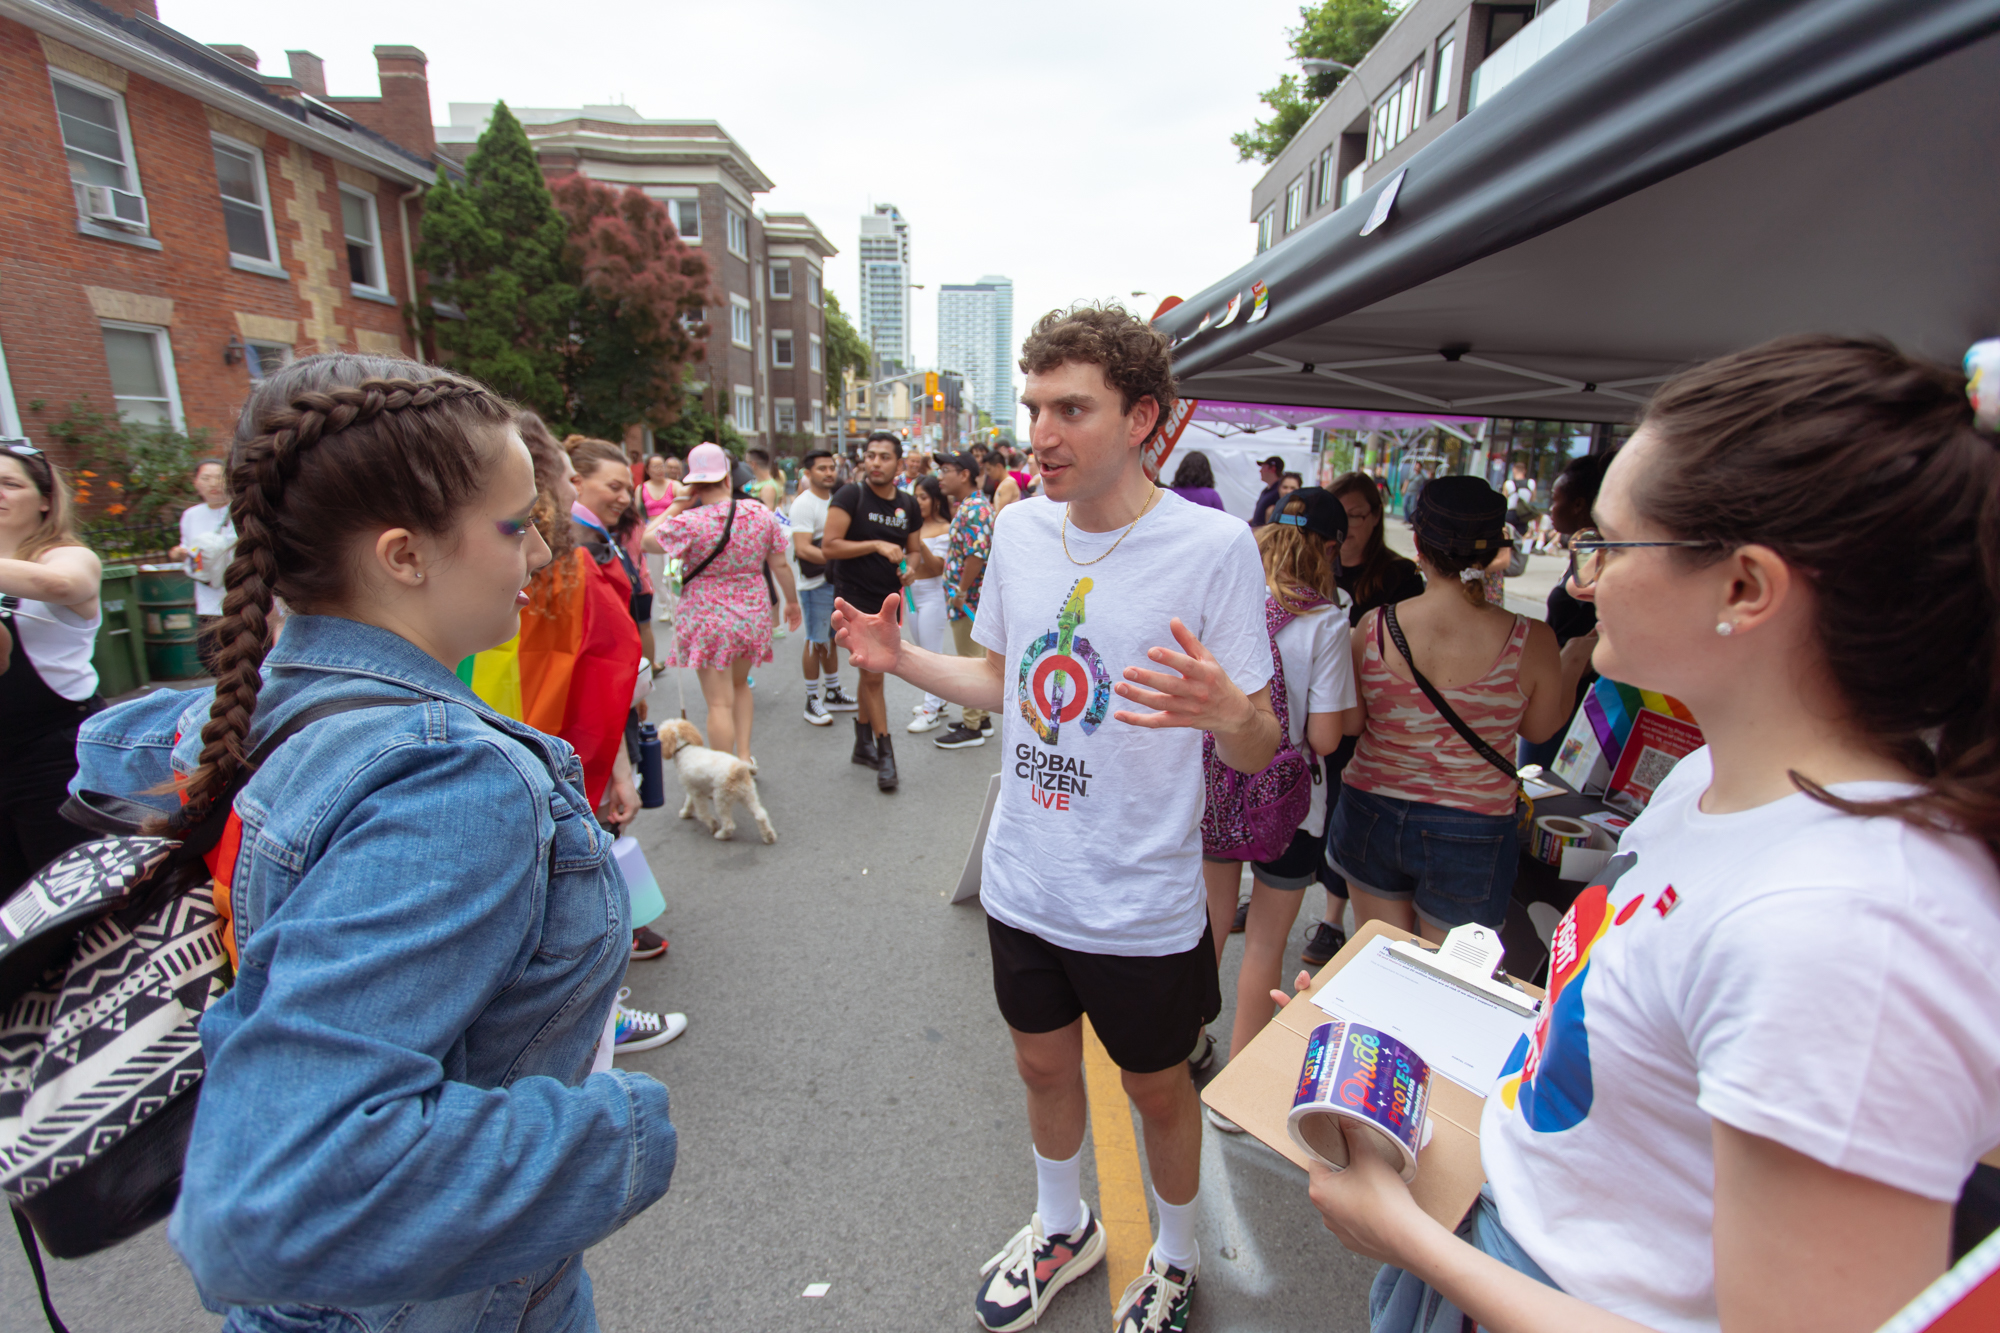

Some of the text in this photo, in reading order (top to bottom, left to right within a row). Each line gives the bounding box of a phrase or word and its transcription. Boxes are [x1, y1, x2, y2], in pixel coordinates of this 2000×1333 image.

[1164, 398, 1193, 438] sid
[1015, 743, 1093, 779] GLOBAL
[1031, 783, 1070, 811] LIVE
[1556, 904, 1578, 974] FIGHT
[1298, 1034, 1320, 1097] PROTEST
[1315, 1045, 1324, 1064] AIDS
[1339, 1033, 1380, 1113] Pride
[1388, 1046, 1410, 1127] PROTEST
[1403, 1078, 1416, 1116] End AIDS
